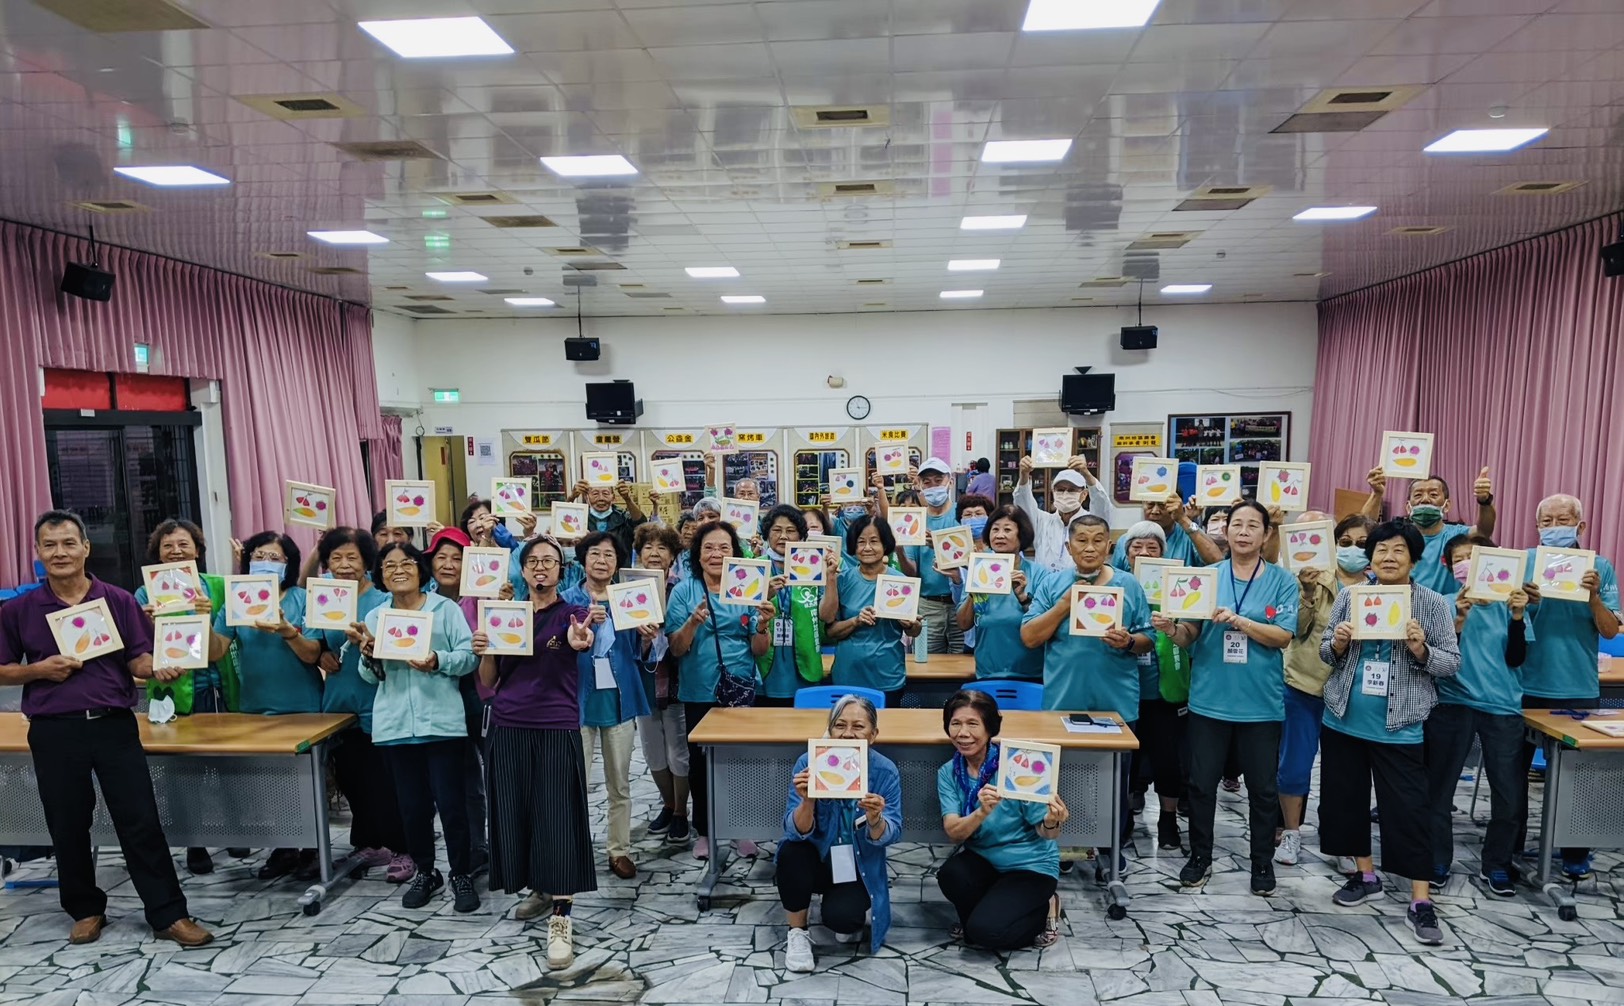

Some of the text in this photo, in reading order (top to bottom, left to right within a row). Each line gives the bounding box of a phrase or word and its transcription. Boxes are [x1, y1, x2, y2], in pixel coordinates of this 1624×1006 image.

[667, 434, 692, 443] 公益金
[881, 430, 906, 439] 米食比賽
[524, 435, 549, 444] 雙瓜節
